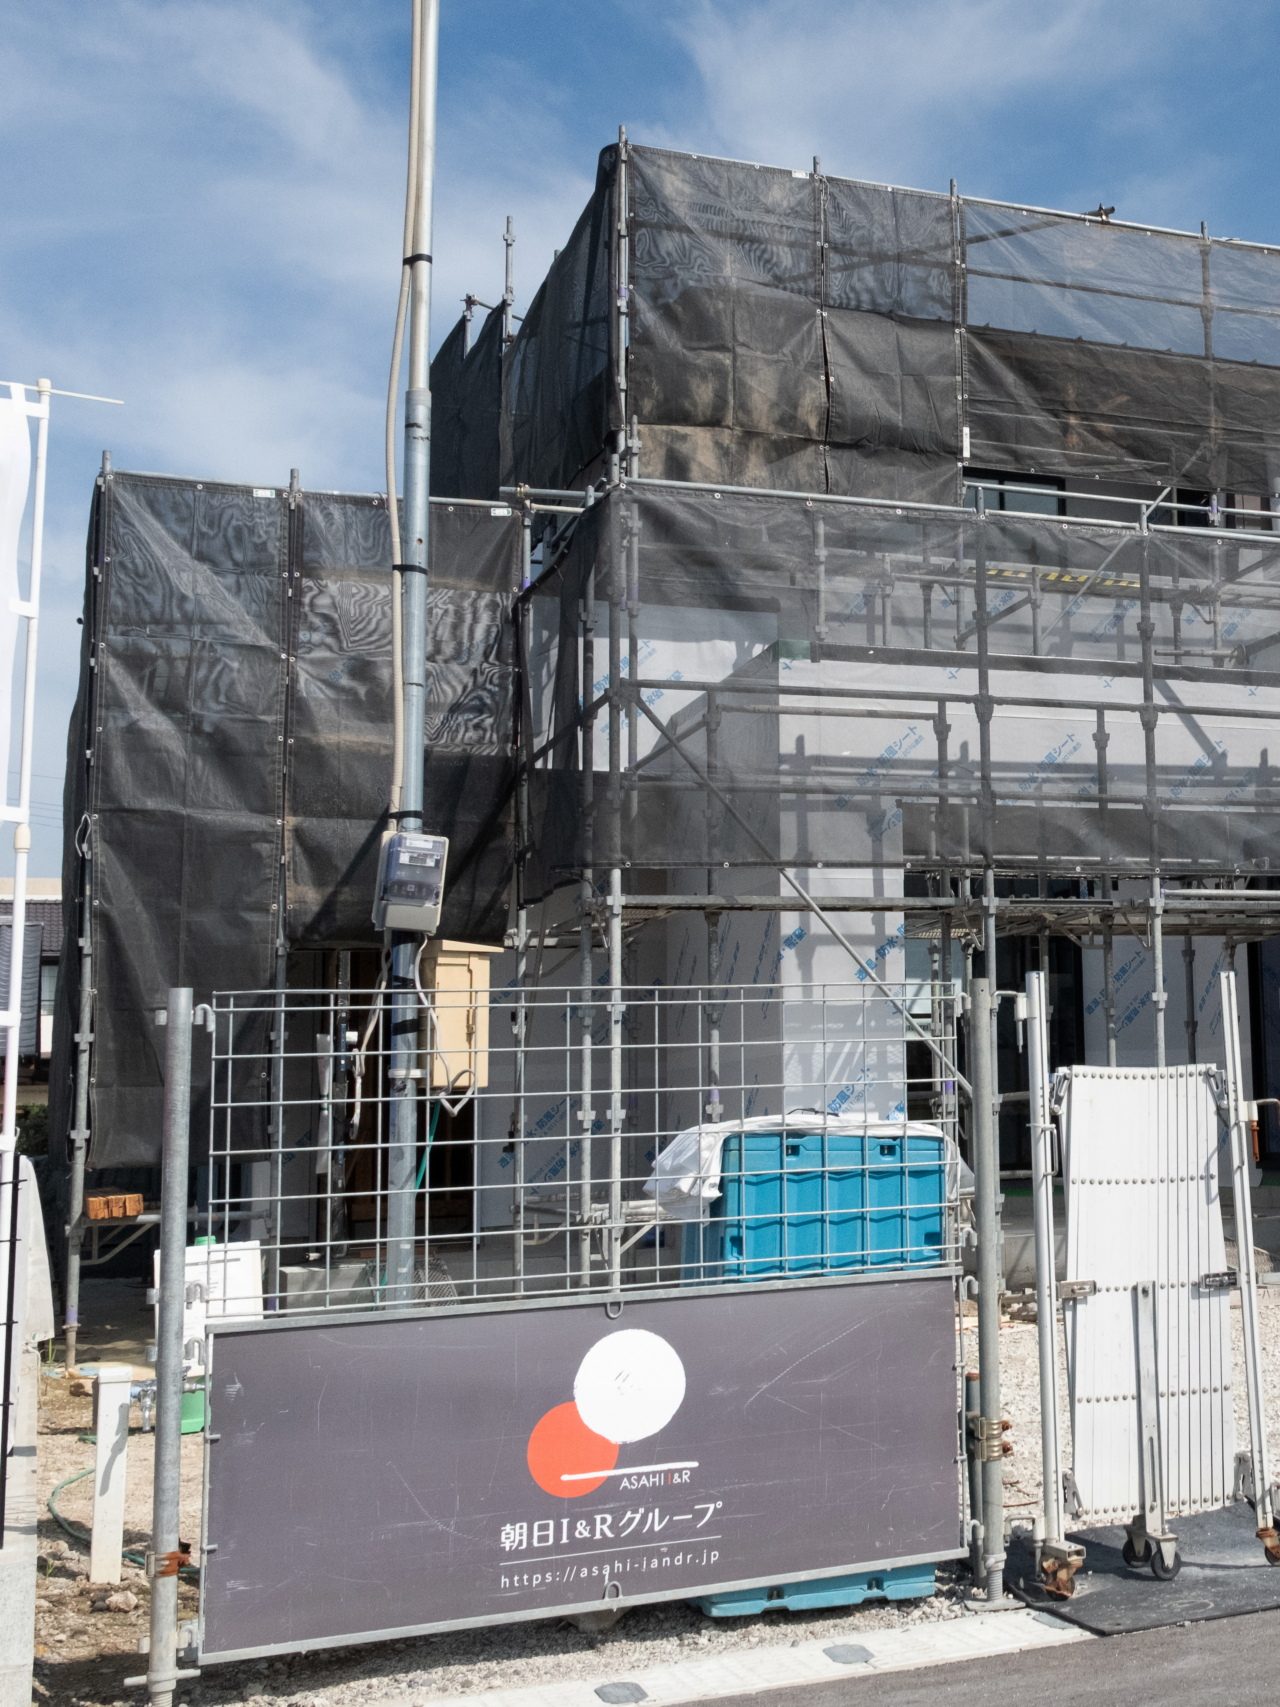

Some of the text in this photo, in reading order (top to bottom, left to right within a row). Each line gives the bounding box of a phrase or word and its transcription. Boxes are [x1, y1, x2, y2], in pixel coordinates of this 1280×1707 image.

[619, 1469, 691, 1491] ASAHI I&R
[500, 1501, 723, 1552] 朝日I&Rグループ
